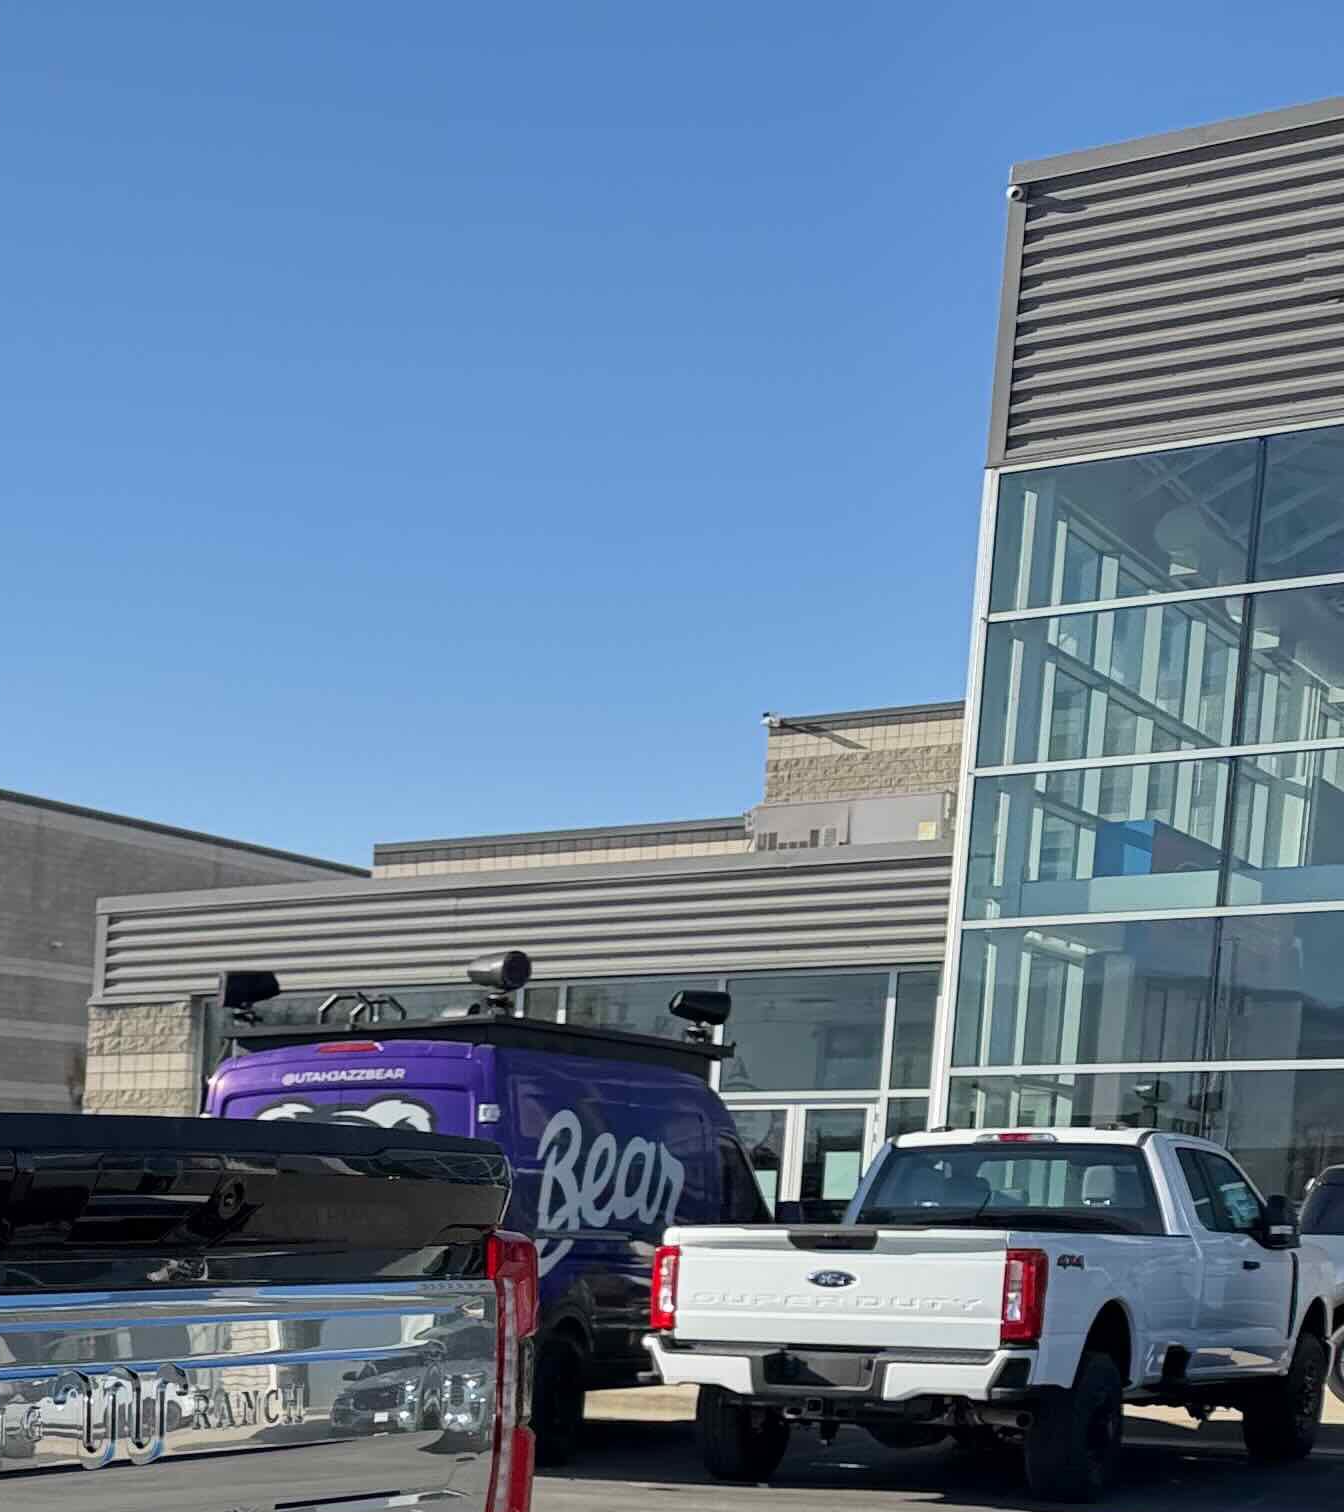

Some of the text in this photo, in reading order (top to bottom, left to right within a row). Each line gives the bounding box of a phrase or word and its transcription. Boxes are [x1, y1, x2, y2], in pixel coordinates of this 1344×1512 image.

[281, 1068, 406, 1086] @UTAHJAZZBEAR
[535, 1110, 685, 1278] Bear
[690, 1291, 984, 1312] SUPER DUTY
[192, 1384, 305, 1431] RANCH
